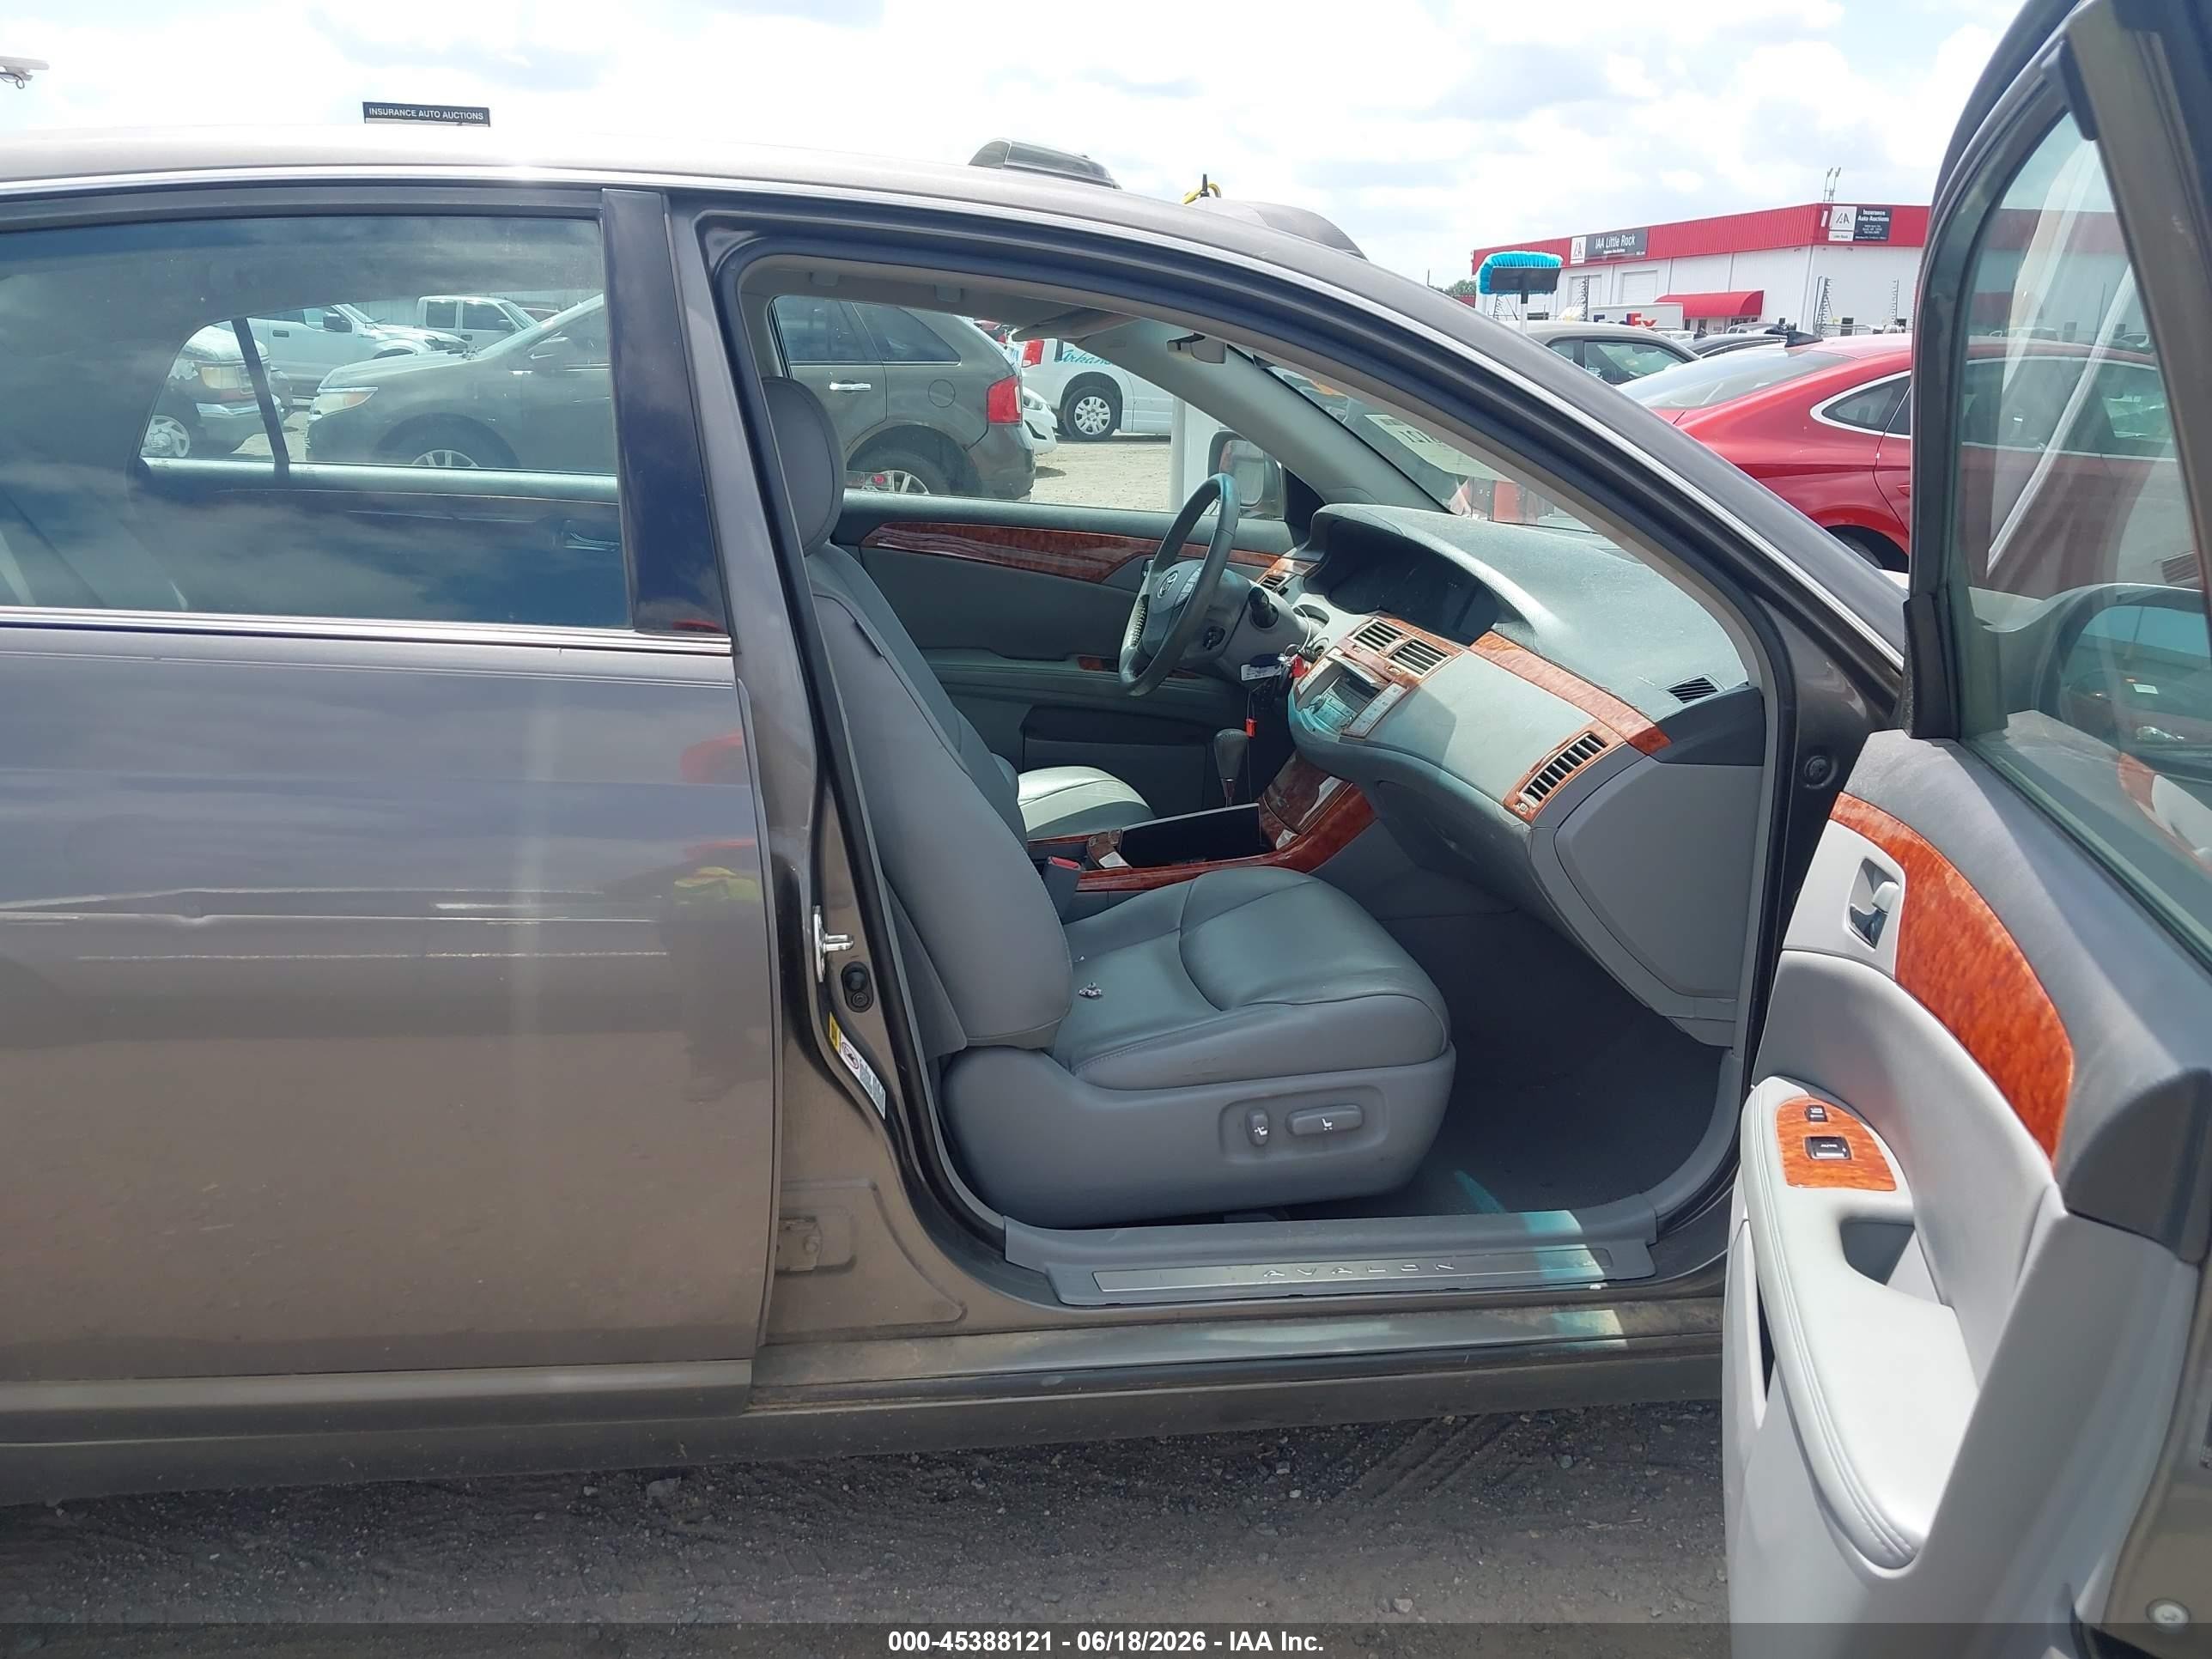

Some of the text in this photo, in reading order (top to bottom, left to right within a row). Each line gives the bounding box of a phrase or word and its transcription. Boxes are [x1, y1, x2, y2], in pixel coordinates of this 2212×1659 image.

[368, 107, 483, 120] INSURANCE AUTO AUCTIONS
[1606, 235, 1620, 248] Little
[1620, 234, 1635, 246] Rock
[1263, 1262, 1455, 1278] AVALON
